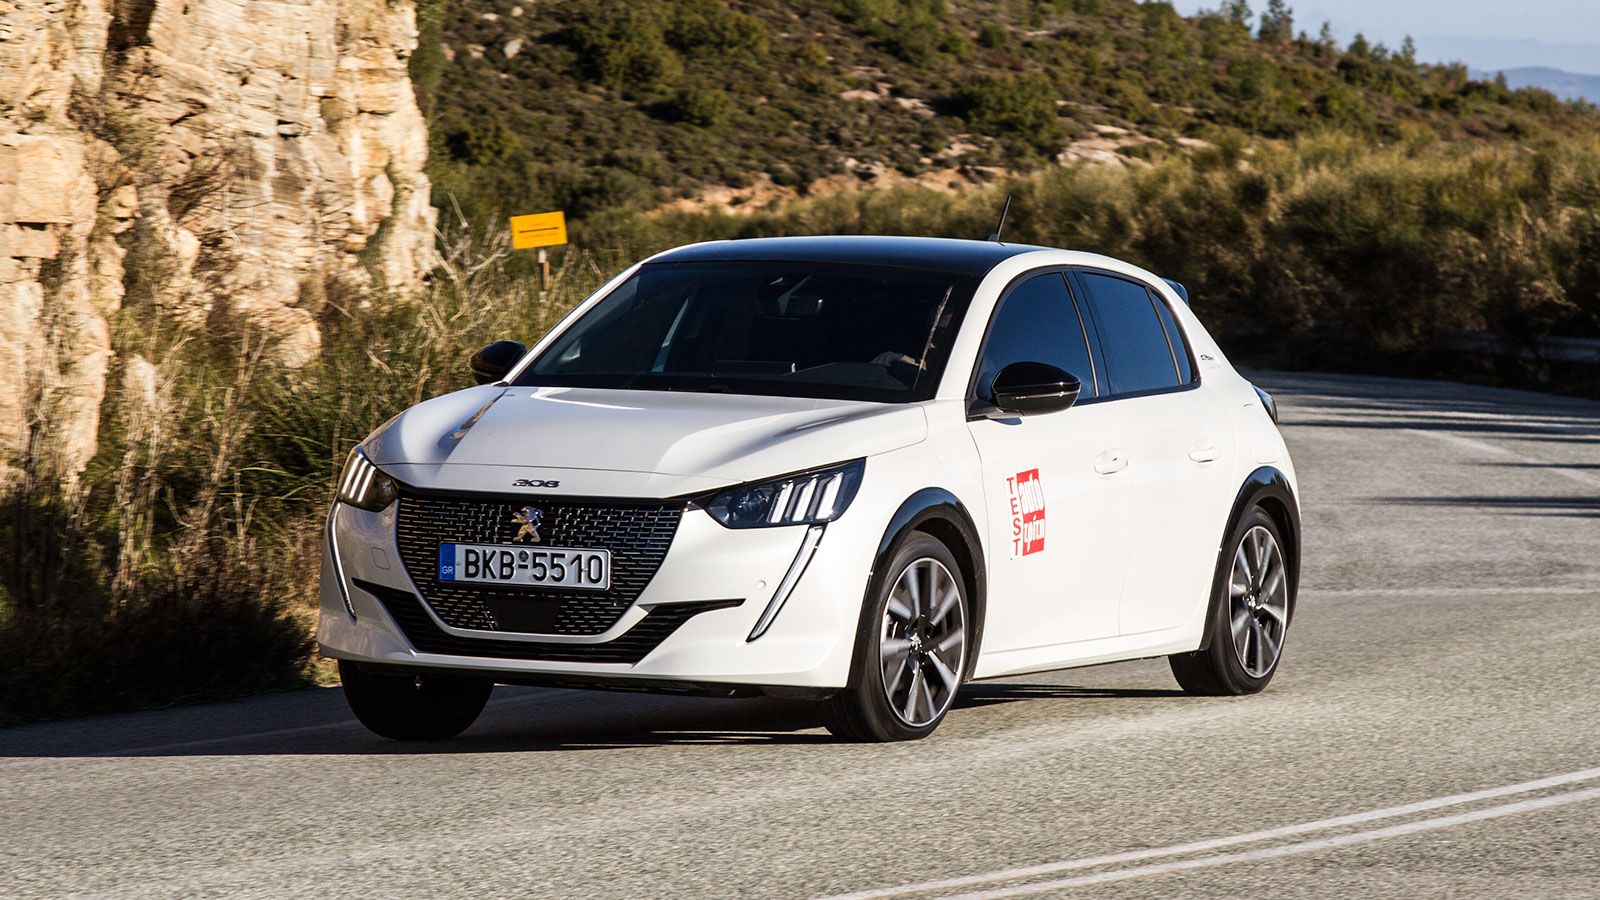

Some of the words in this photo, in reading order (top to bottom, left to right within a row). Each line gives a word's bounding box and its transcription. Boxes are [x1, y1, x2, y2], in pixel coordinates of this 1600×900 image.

[1018, 472, 1045, 514] auto
[1006, 477, 1021, 556] TEST
[441, 566, 454, 574] GR
